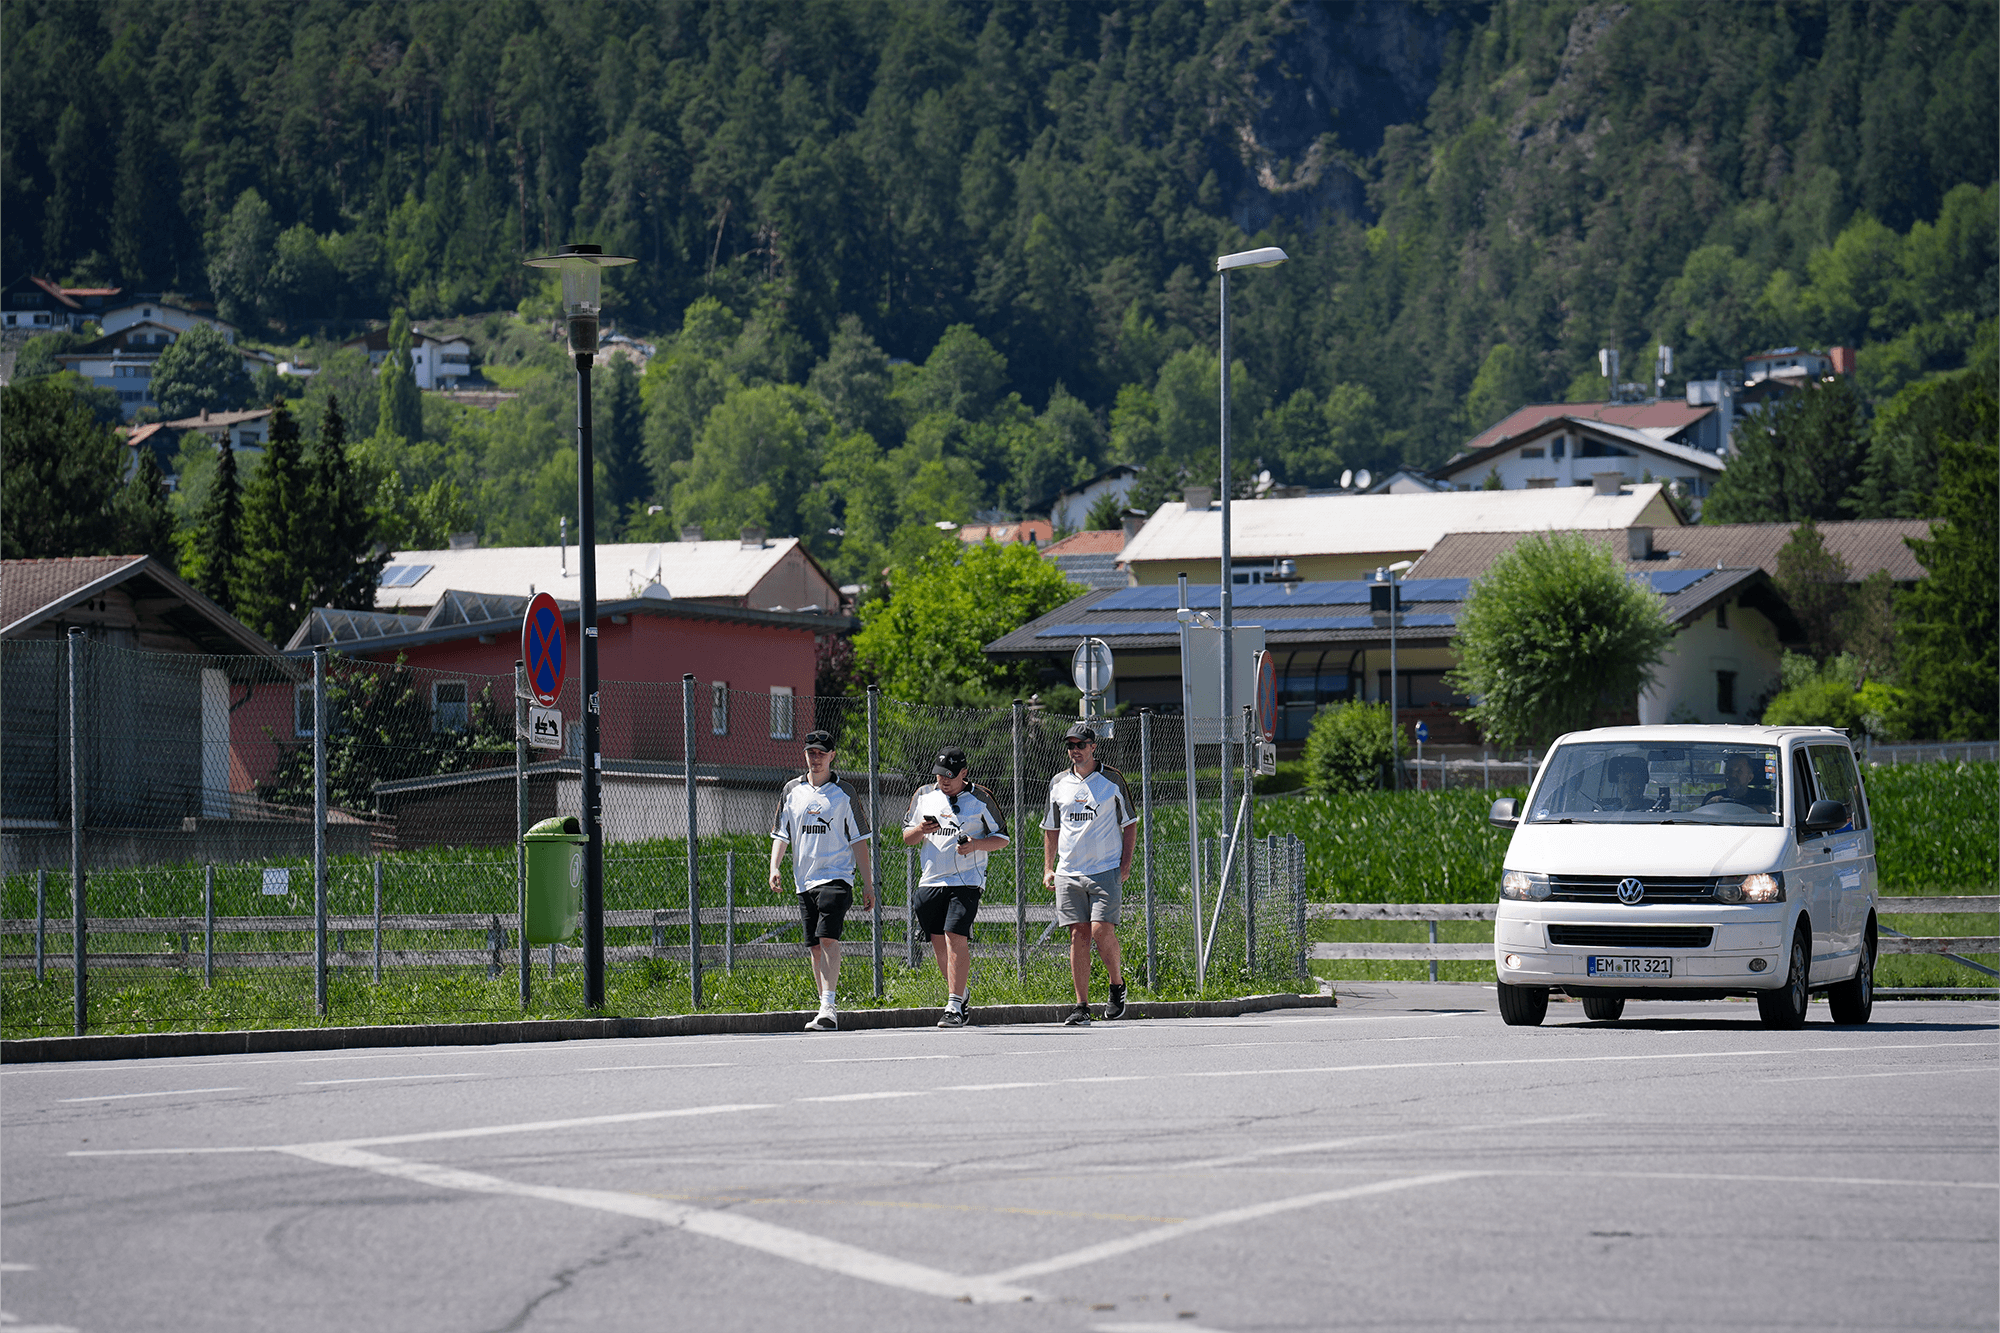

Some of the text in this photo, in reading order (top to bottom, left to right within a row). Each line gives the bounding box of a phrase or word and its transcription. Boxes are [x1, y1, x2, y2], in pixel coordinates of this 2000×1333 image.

[1069, 812, 1093, 821] PUMA
[802, 825, 826, 834] PUMA
[1596, 958, 1669, 973] EM TR 321
